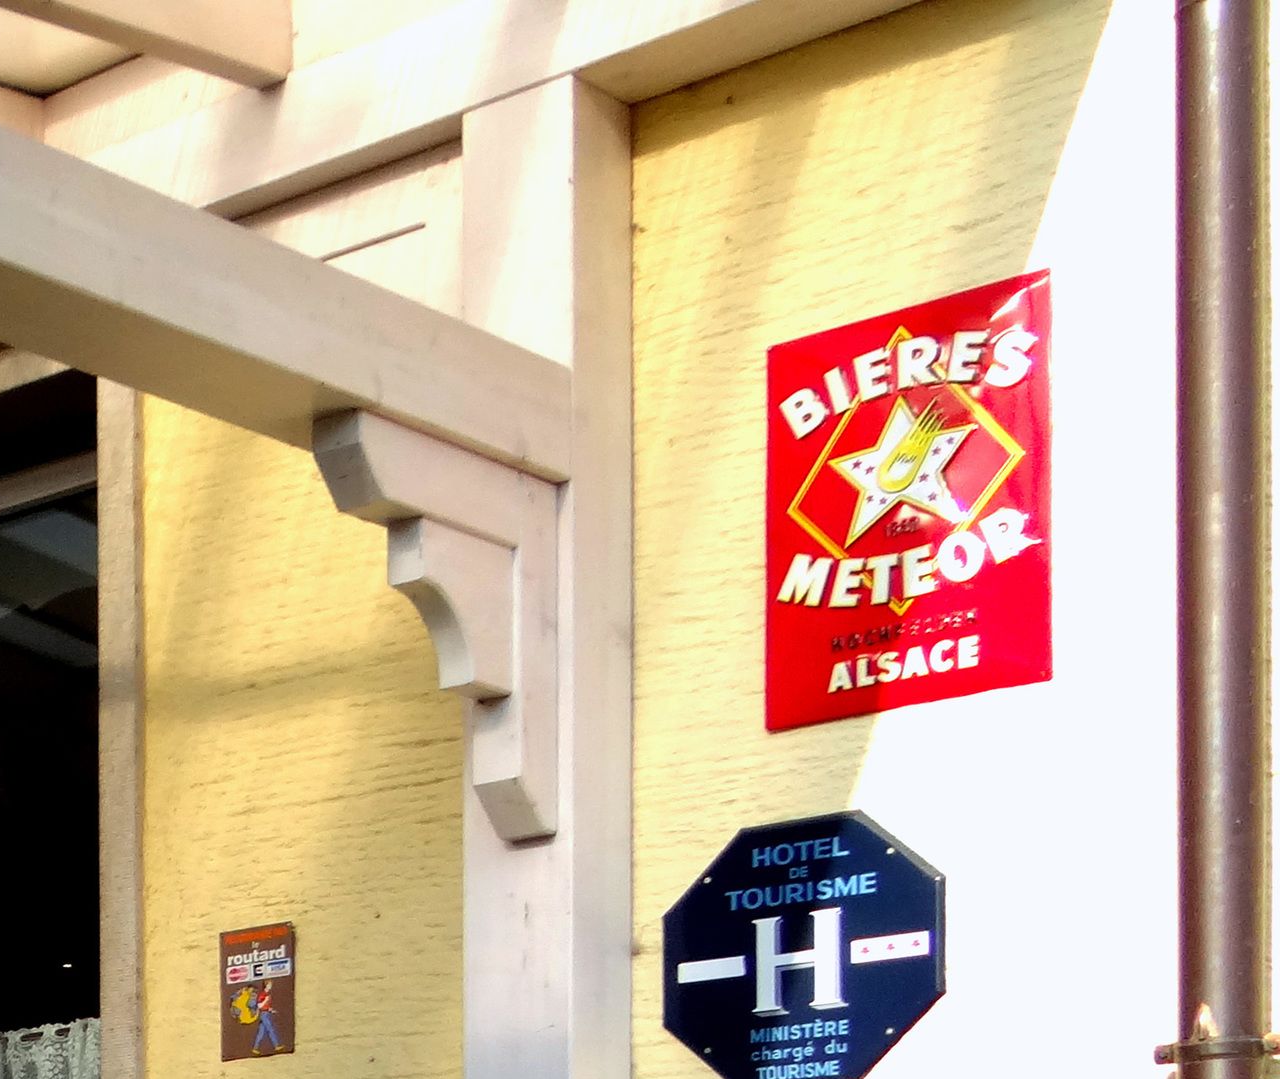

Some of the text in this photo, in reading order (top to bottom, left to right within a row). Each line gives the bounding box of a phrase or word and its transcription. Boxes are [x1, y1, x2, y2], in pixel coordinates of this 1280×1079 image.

[778, 323, 1040, 441] BIERES
[776, 506, 1042, 609] METEOR
[826, 633, 981, 695] ALSACE
[751, 836, 851, 869] HOTEL
[788, 865, 809, 880] DE
[724, 871, 878, 912] TOURISME
[226, 943, 286, 967] routard
[750, 906, 850, 1018] H
[750, 1018, 850, 1044] MINISTÈRE
[751, 1039, 849, 1063] chargé du
